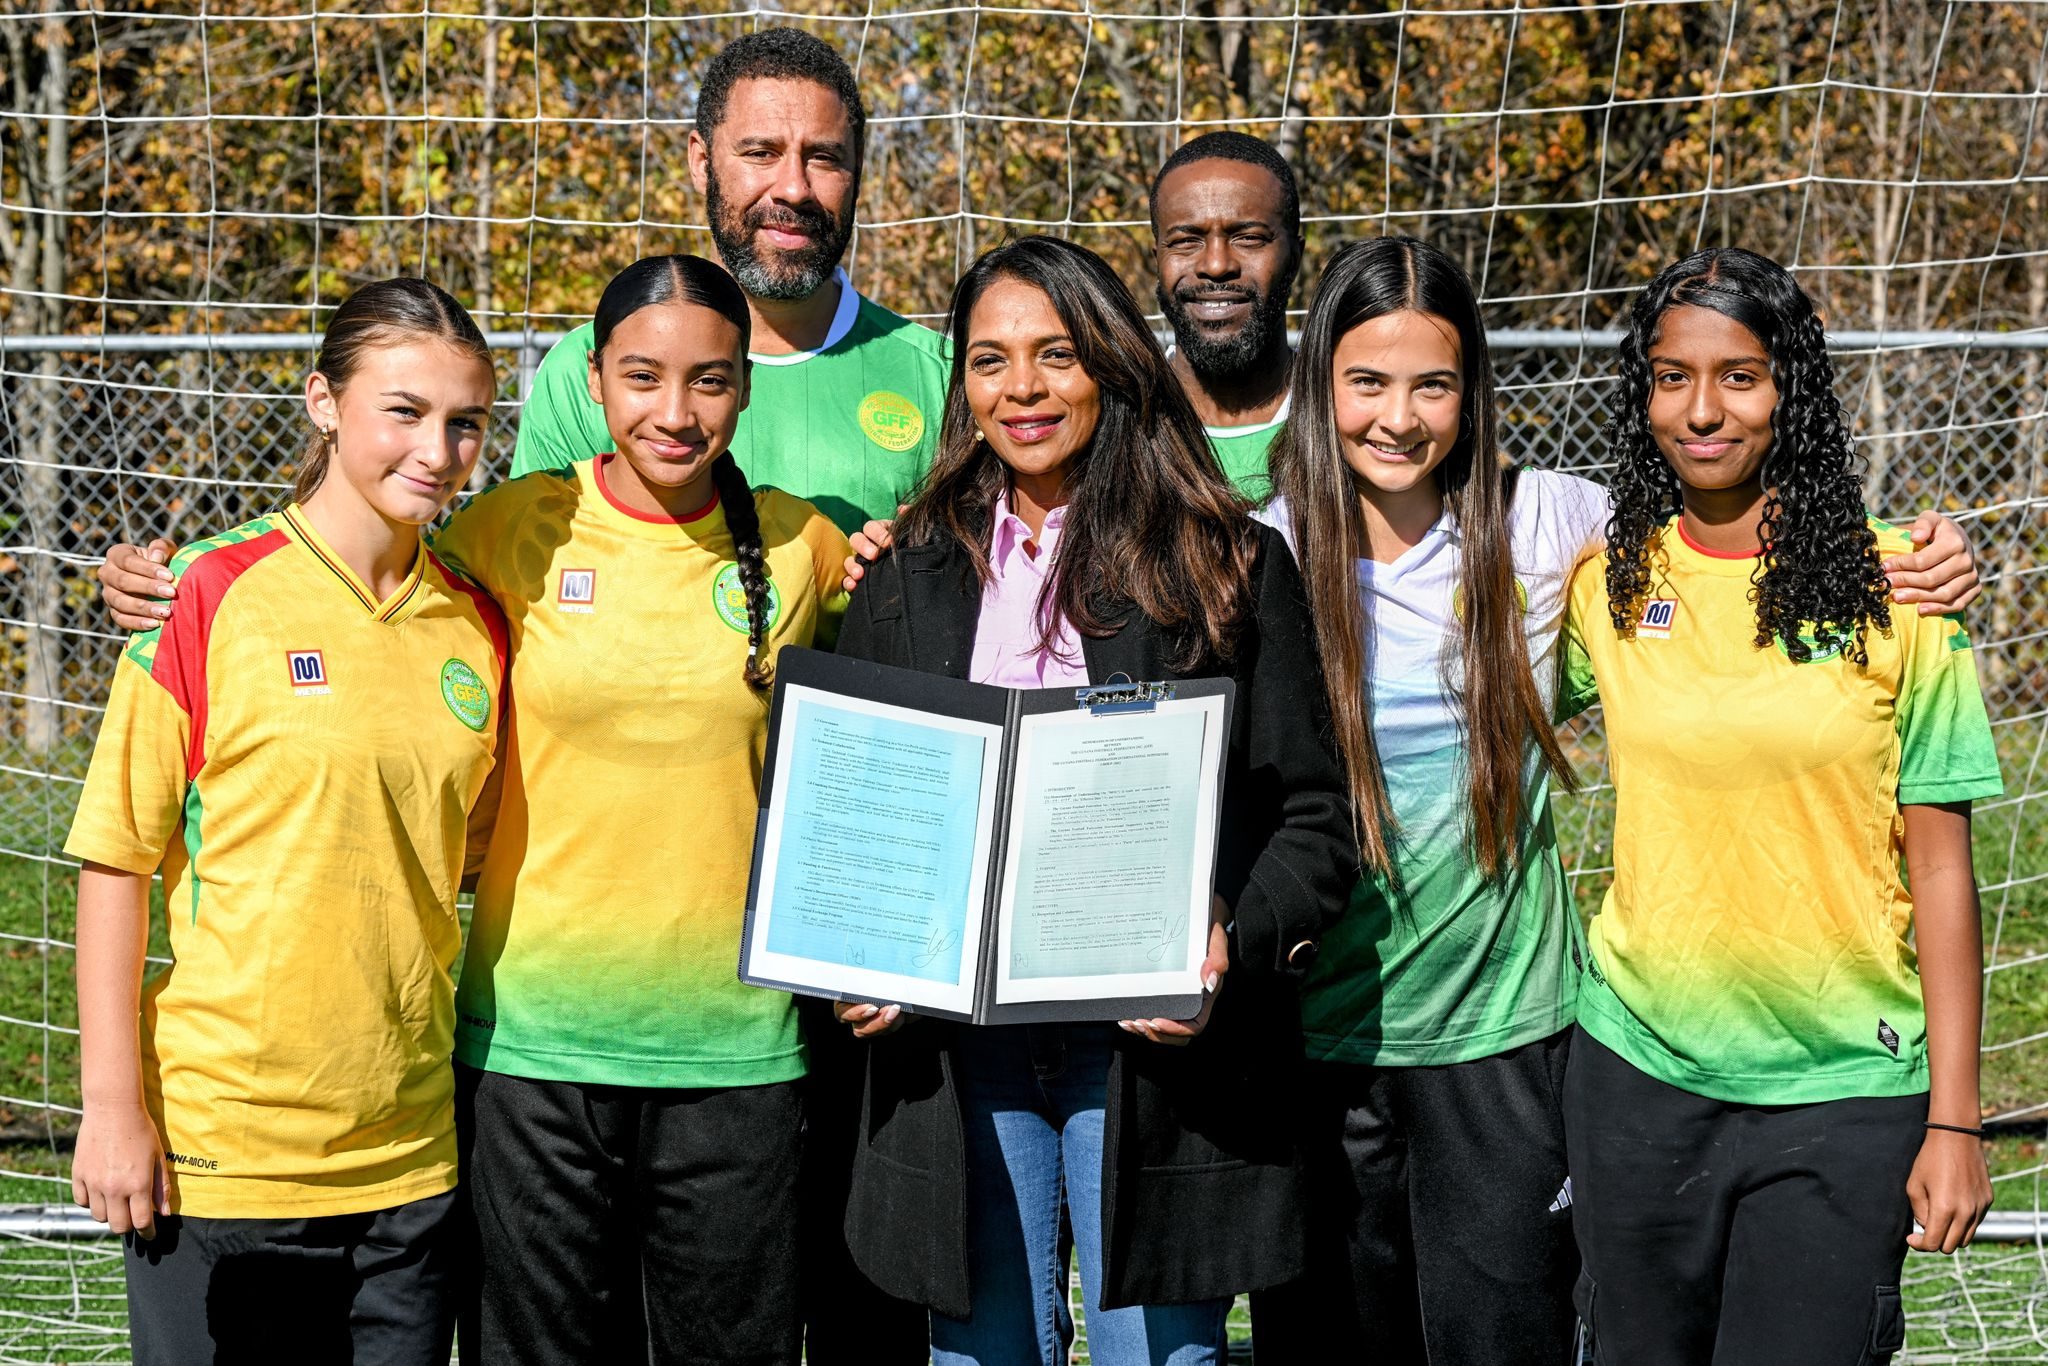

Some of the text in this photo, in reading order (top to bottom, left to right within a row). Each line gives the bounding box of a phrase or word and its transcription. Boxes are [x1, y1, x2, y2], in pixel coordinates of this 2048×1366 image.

[873, 411, 910, 429] GFF
[294, 687, 334, 697] MEYBA
[453, 683, 483, 704] GFF
[165, 1151, 218, 1170] MNI-MOVE
